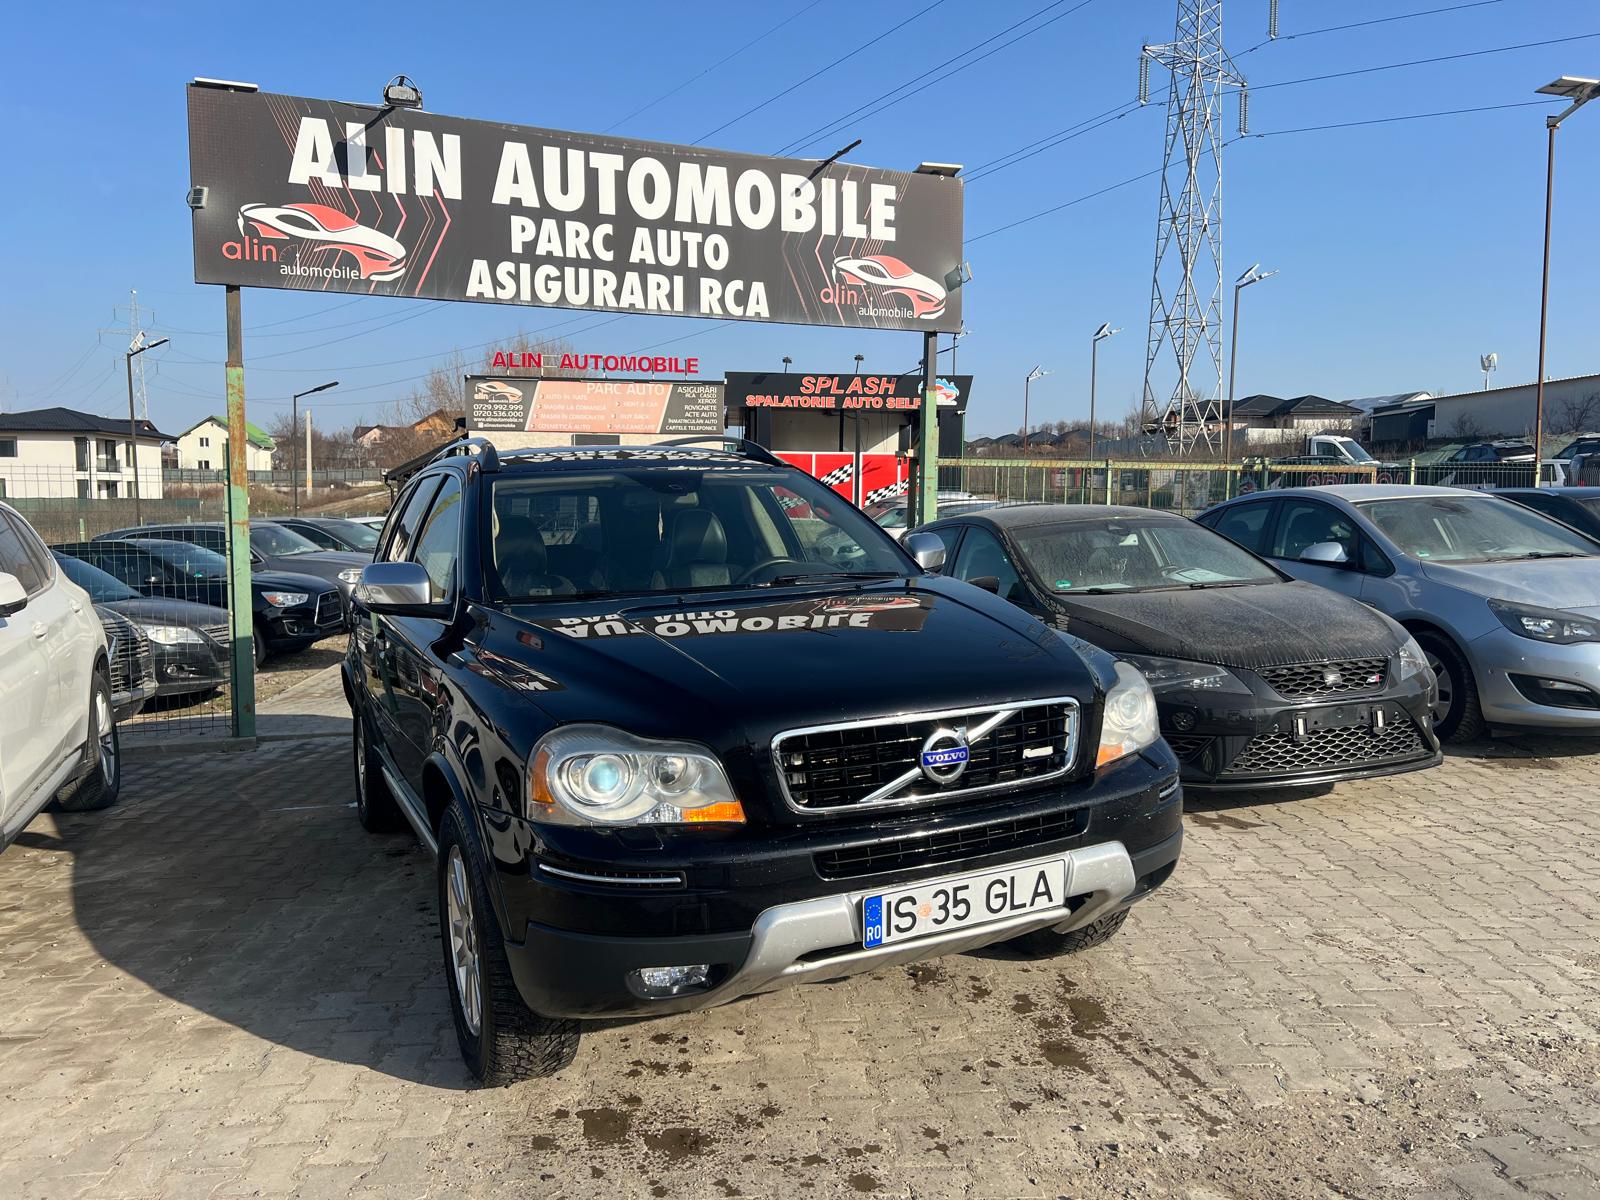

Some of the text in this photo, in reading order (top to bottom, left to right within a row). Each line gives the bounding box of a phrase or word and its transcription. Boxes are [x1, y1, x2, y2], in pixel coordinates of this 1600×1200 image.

[288, 116, 897, 242] ALIN AUTOMOBILE
[221, 235, 278, 262] alin
[510, 215, 729, 270] PARC AUTO
[465, 259, 770, 318] ASIGURARI RCA
[820, 283, 858, 305] alin
[492, 352, 699, 374] ALIN AUTOMOBILE
[586, 383, 664, 396] PARC AUTO
[800, 375, 897, 395] SPLASH
[745, 394, 836, 408] SPALATORIE
[842, 396, 884, 409] AUTO
[925, 750, 967, 763] VOLVO
[885, 870, 1054, 938] IS 35 GLA
[866, 924, 881, 941] RO
